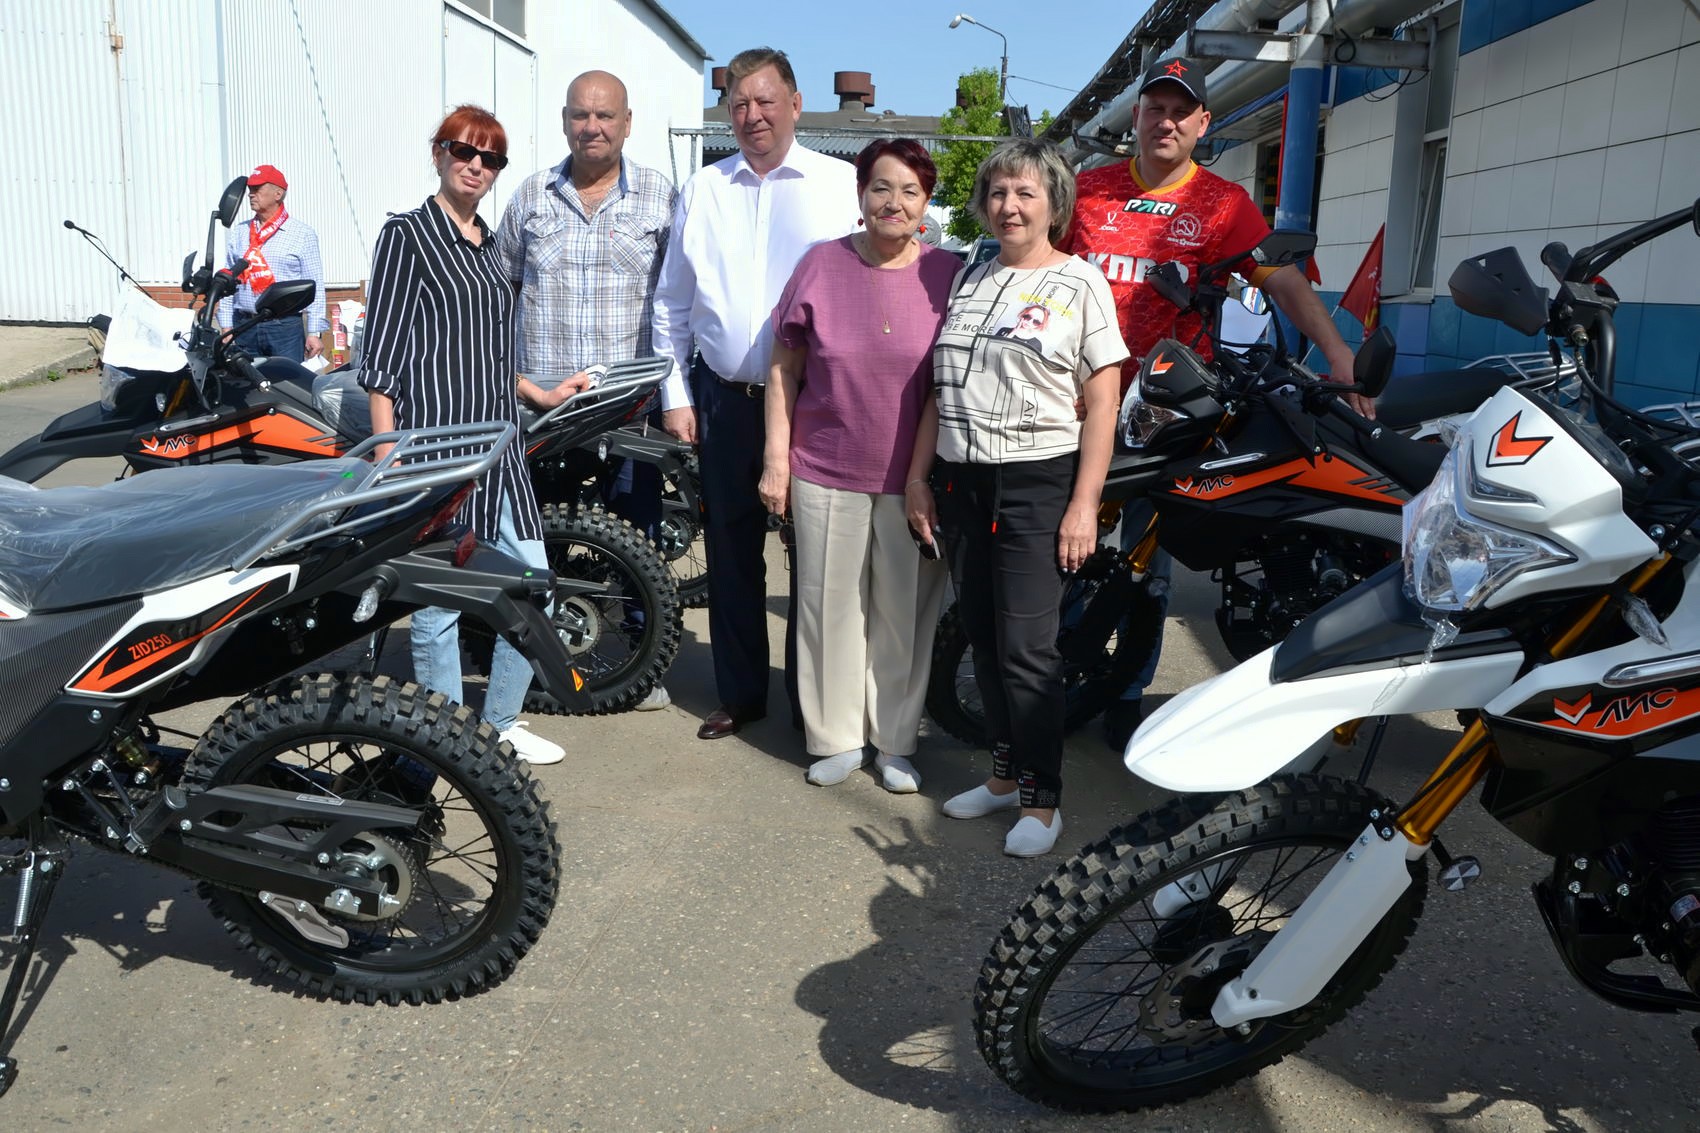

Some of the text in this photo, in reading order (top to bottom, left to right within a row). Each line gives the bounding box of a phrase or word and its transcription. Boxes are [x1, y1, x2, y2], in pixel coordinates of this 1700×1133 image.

[1124, 199, 1177, 216] PARI
[961, 324, 995, 334] MORE
[1021, 400, 1035, 432] AND
[127, 633, 172, 661] ZID250
